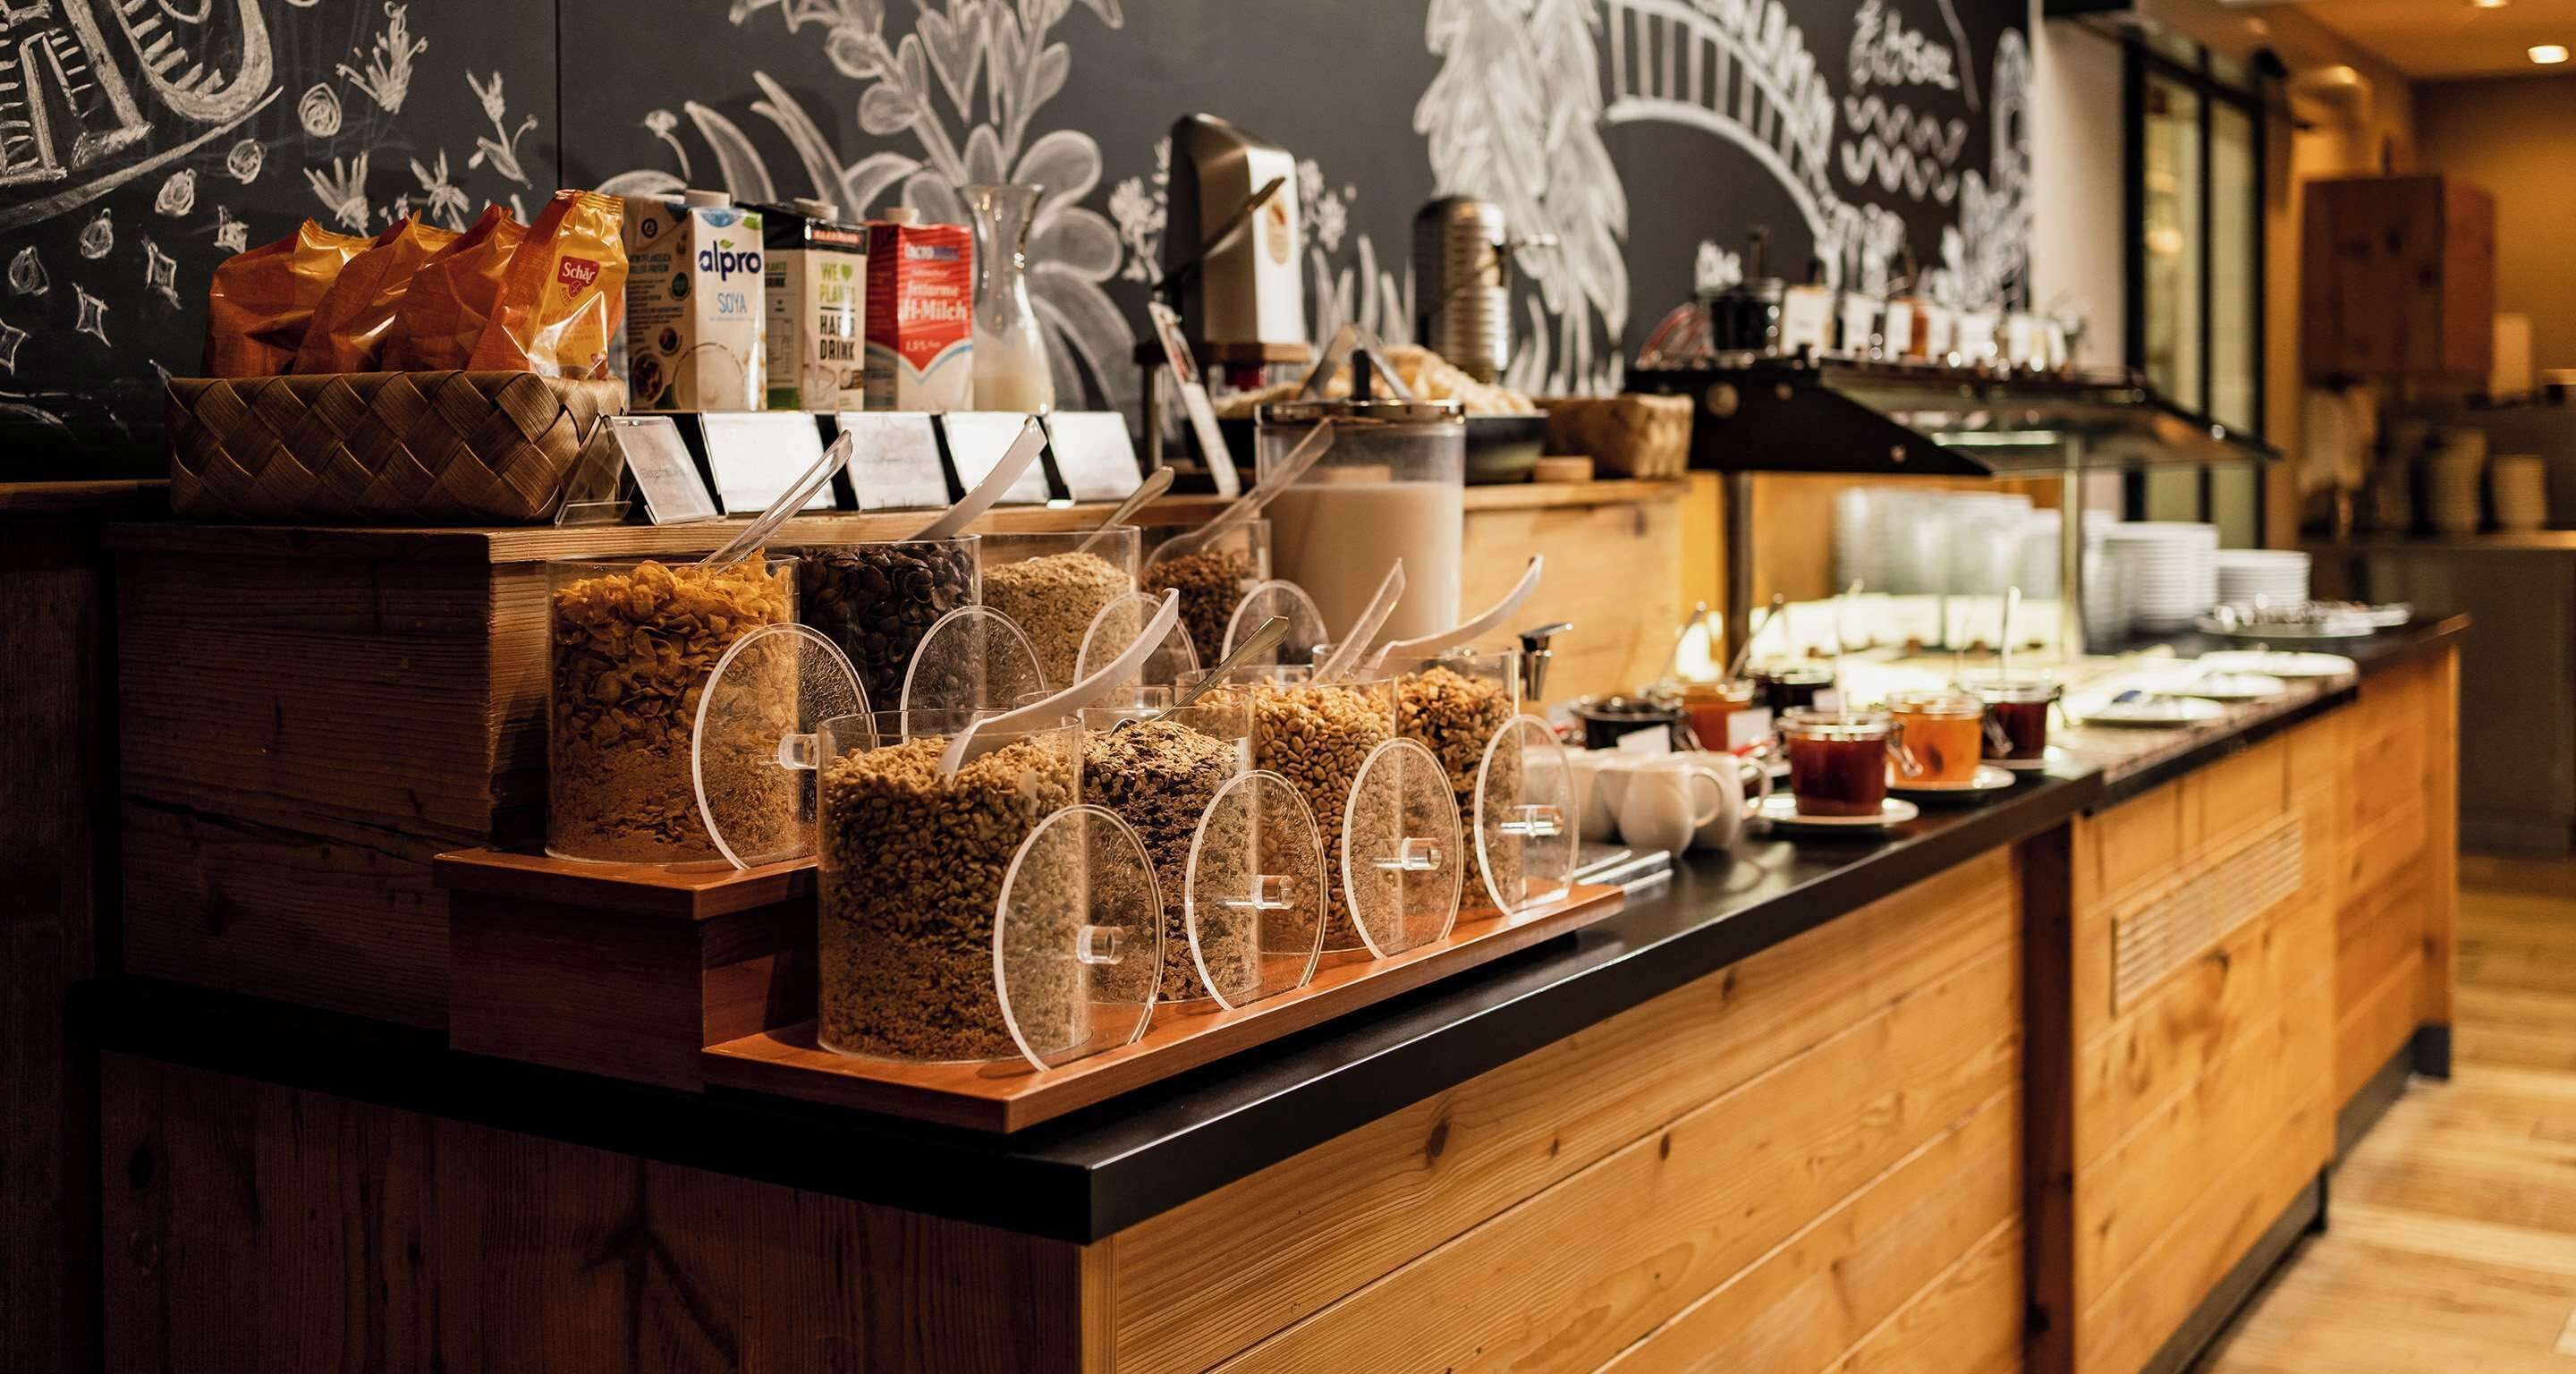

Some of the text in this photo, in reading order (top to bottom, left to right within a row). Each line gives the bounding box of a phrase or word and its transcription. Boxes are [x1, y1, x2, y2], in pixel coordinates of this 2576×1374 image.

[699, 241, 761, 282] alpro
[820, 263, 838, 281] WE
[563, 261, 596, 284] Schär
[717, 293, 748, 314] SOYA
[820, 315, 855, 337] HAFR
[820, 339, 855, 360] DRINK
